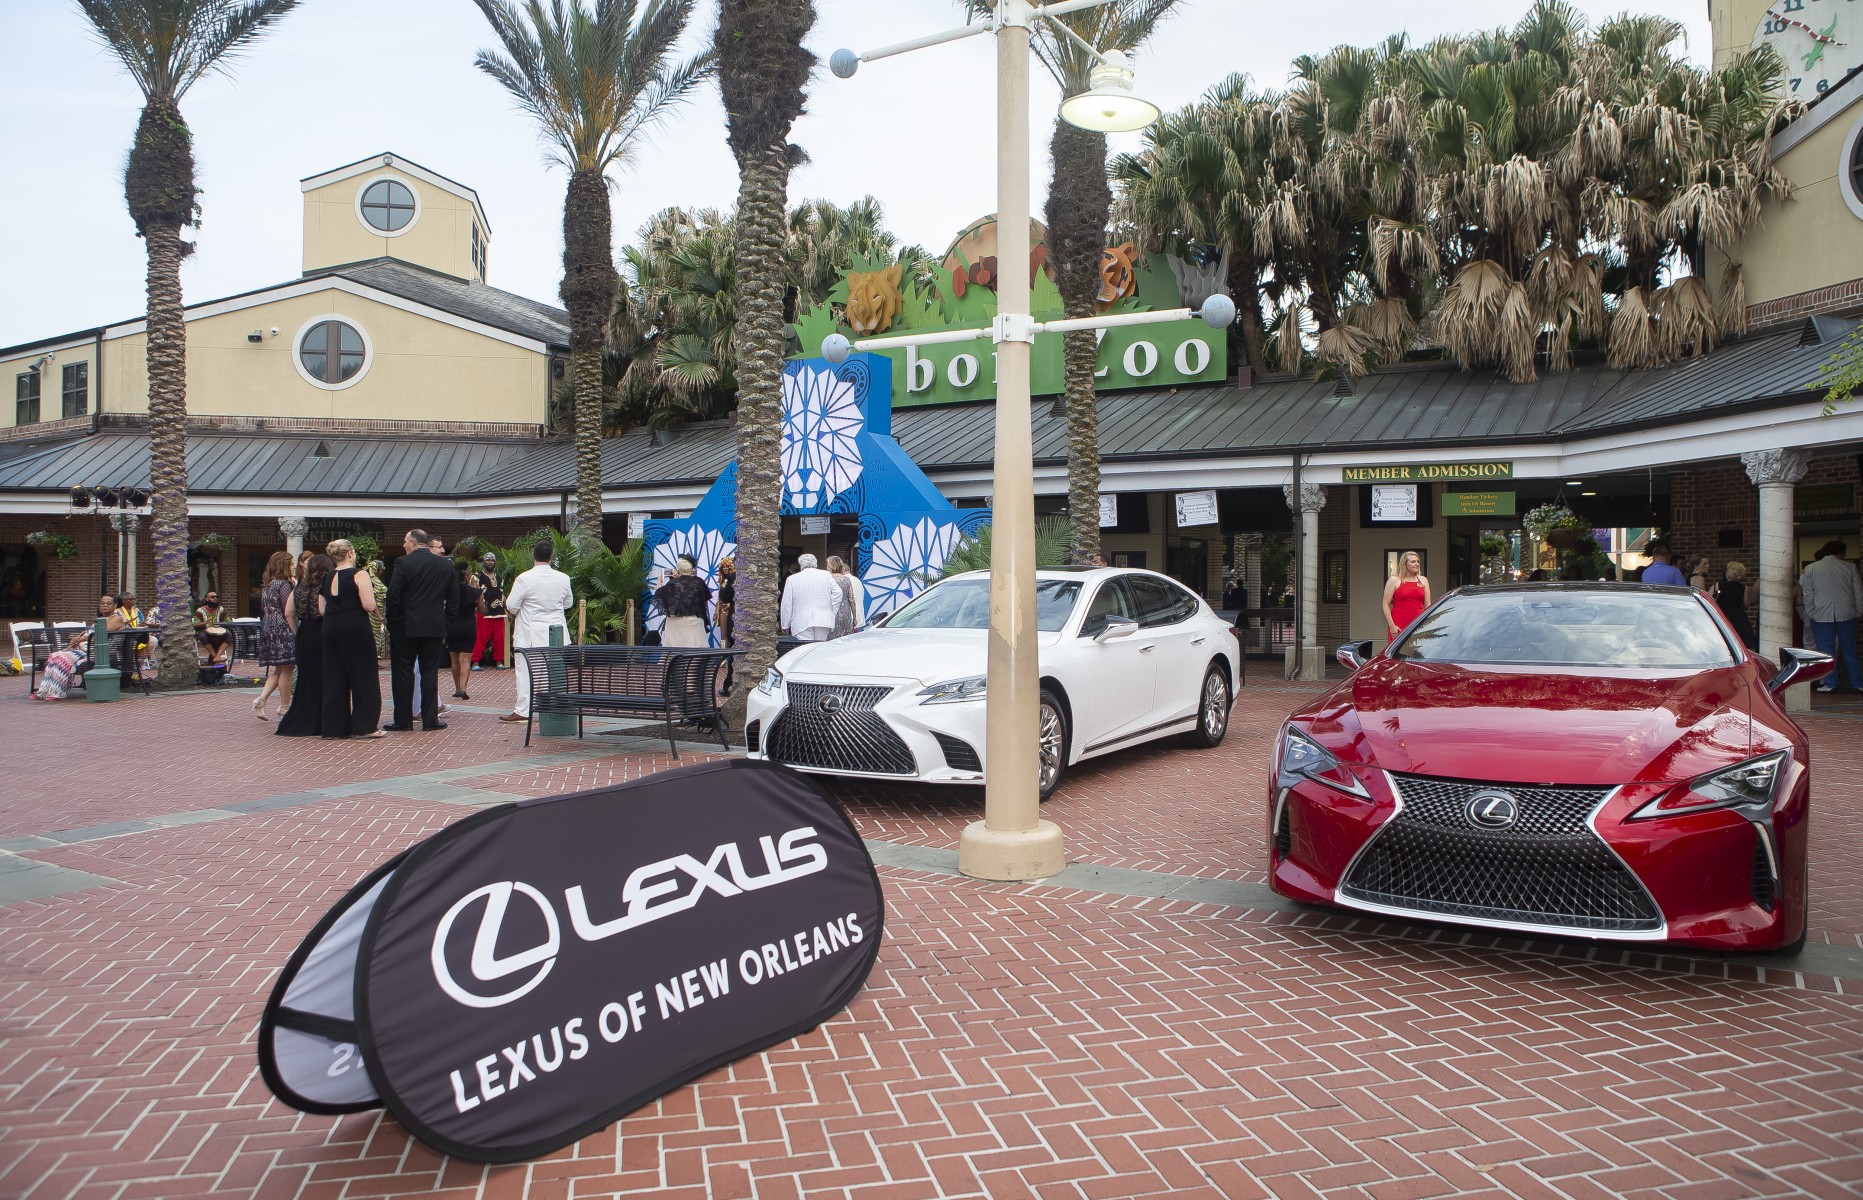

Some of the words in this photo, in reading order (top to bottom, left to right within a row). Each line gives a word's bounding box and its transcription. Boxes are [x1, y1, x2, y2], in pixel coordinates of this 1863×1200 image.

[1764, 20, 1787, 35] 10
[1789, 77, 1802, 92] 7
[1816, 79, 1829, 93] 6
[1345, 466, 1410, 480] MEMBER
[1417, 463, 1509, 478] ADMISSION
[308, 519, 362, 531] udubon
[564, 826, 828, 941] LEXUS
[449, 1017, 589, 1114] LEXUS
[598, 991, 647, 1043] OF
[655, 958, 730, 1020] NEW
[739, 912, 864, 985] ORLEANS
